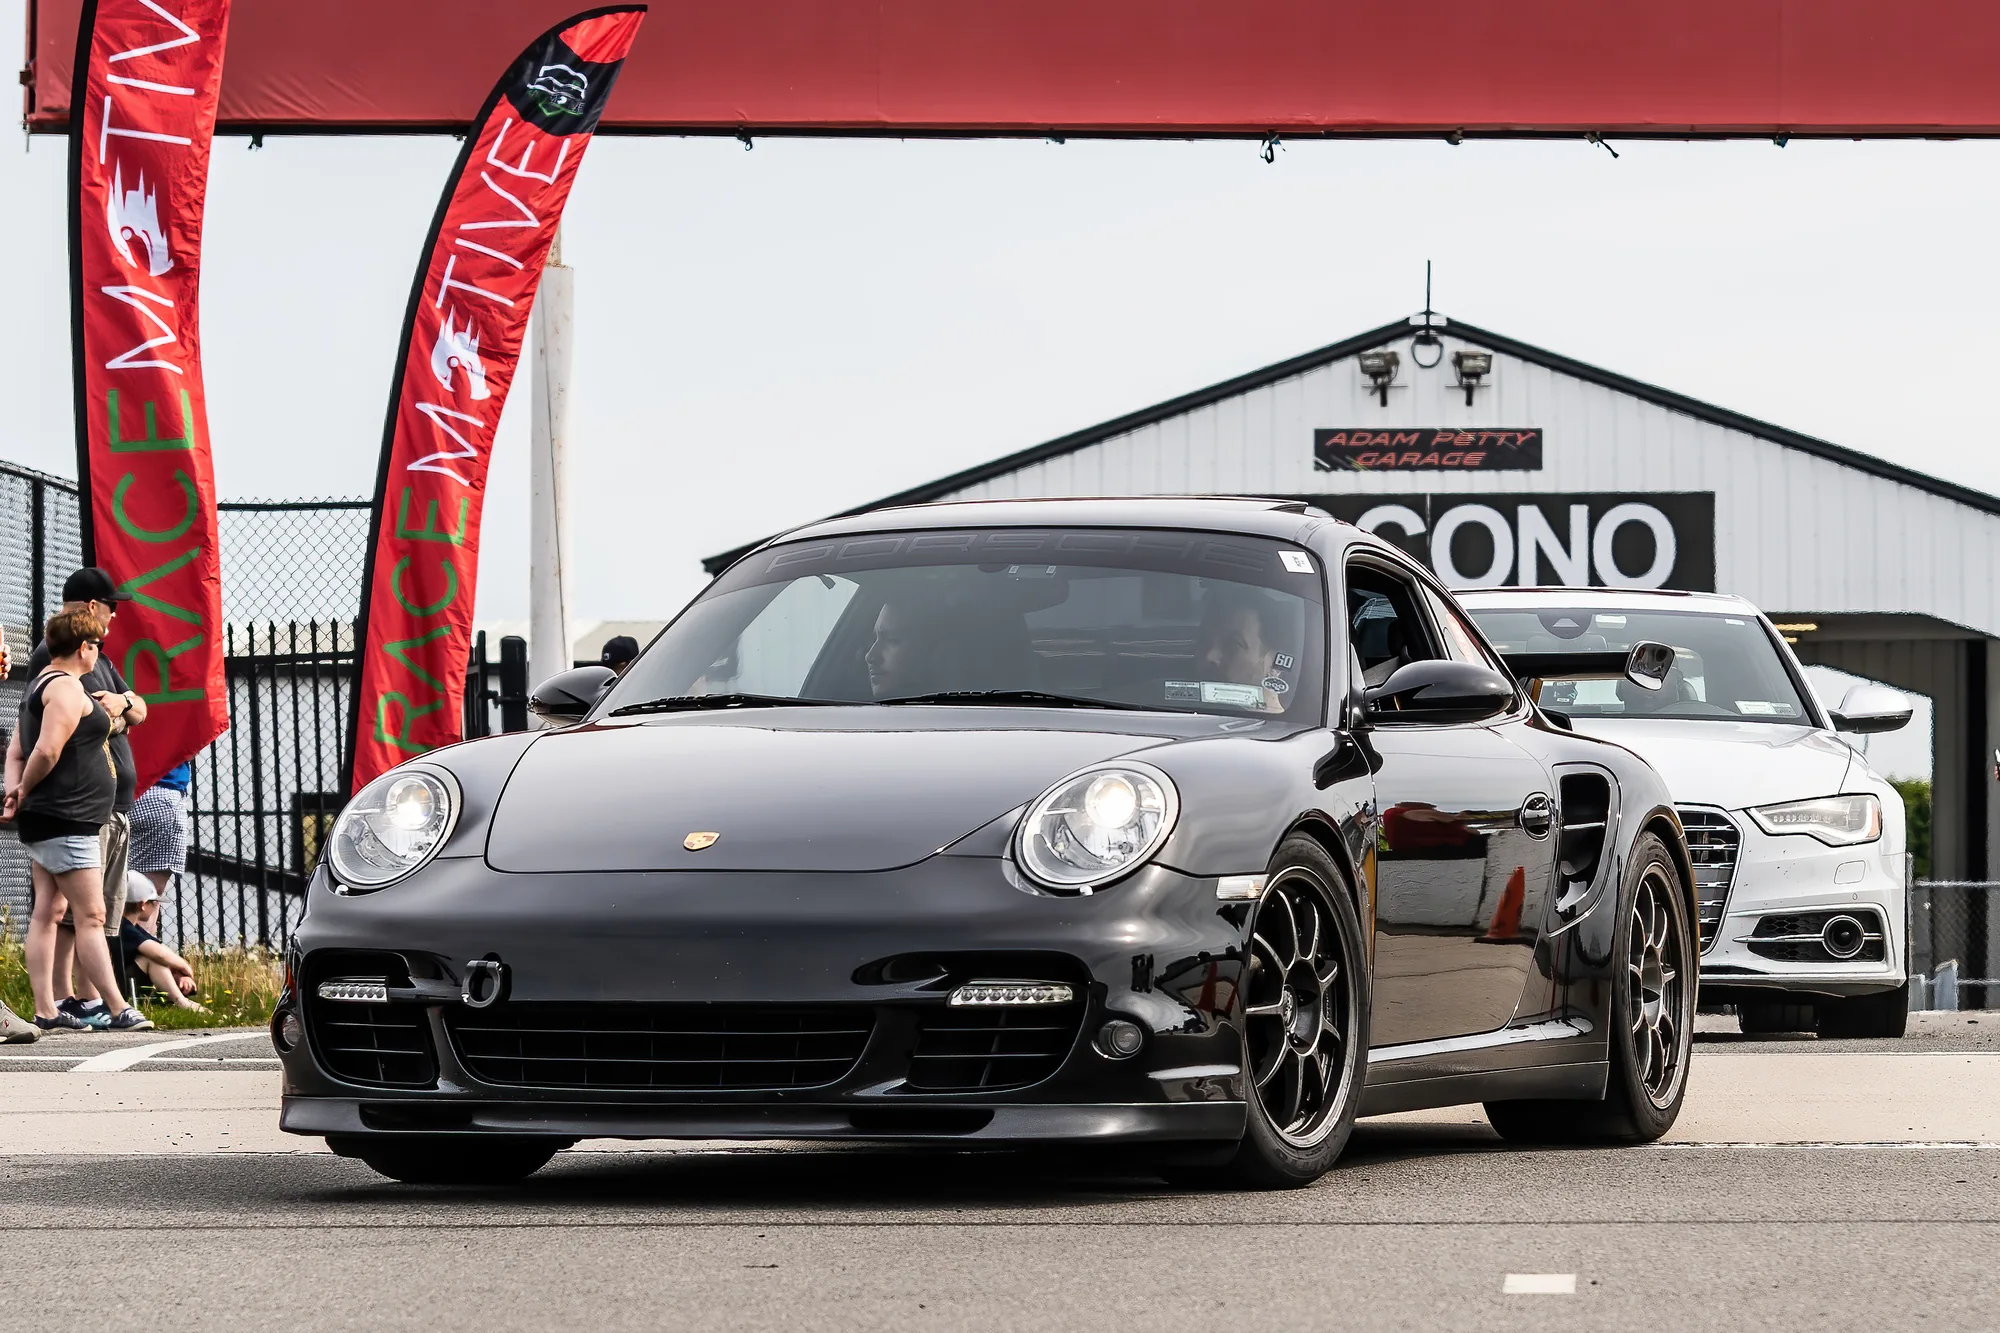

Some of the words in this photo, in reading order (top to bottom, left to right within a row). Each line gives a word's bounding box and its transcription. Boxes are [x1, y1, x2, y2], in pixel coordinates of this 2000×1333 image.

[1325, 432, 1420, 446] ADAM
[1432, 431, 1537, 446] PETTY
[1356, 452, 1487, 467] GARAGE
[764, 533, 1272, 574] PORSCHE
